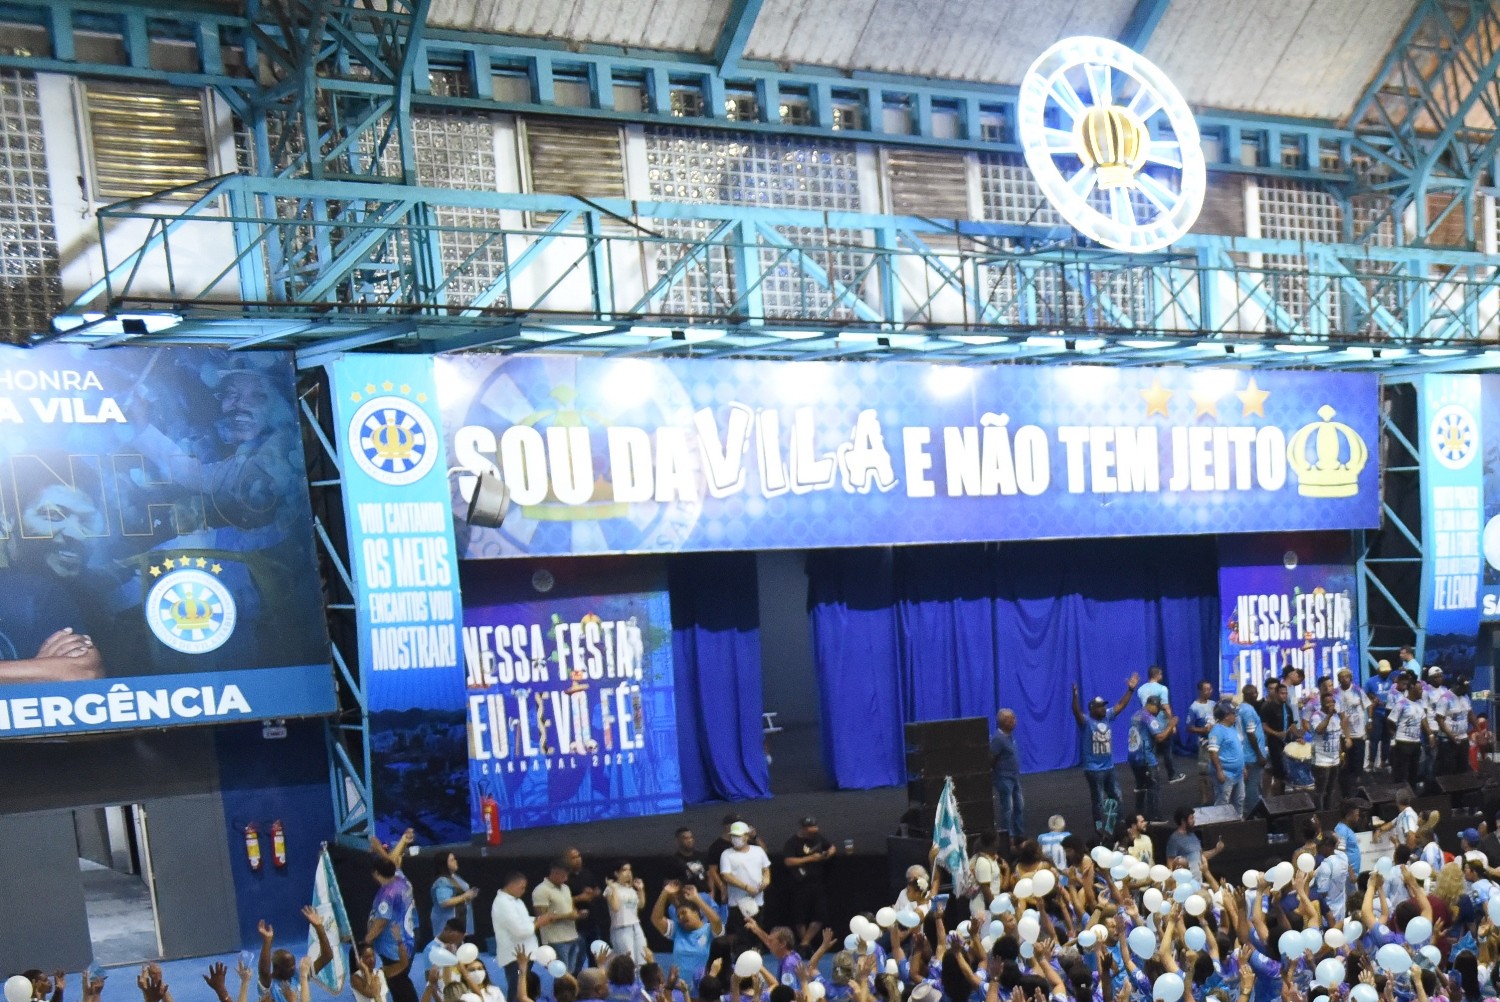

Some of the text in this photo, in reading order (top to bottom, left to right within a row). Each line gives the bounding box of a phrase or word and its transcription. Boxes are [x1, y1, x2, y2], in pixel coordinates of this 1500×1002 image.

[29, 397, 128, 423] VILA
[453, 400, 1287, 506] SOU DA VILA E NÃO TEM JEITO
[357, 502, 446, 534] VOU CANTANDO
[363, 536, 451, 589] OS MEUS
[368, 590, 455, 624] ENCANTOS VOU
[1237, 594, 1291, 642] NESSA
[371, 624, 457, 671] MOSTRAR!
[462, 623, 549, 687] NESSA
[0, 683, 252, 730] ERGÊNCIA
[469, 681, 645, 760] EU LEVO FÉ!
[482, 753, 635, 775] CARNAVAL 2023
